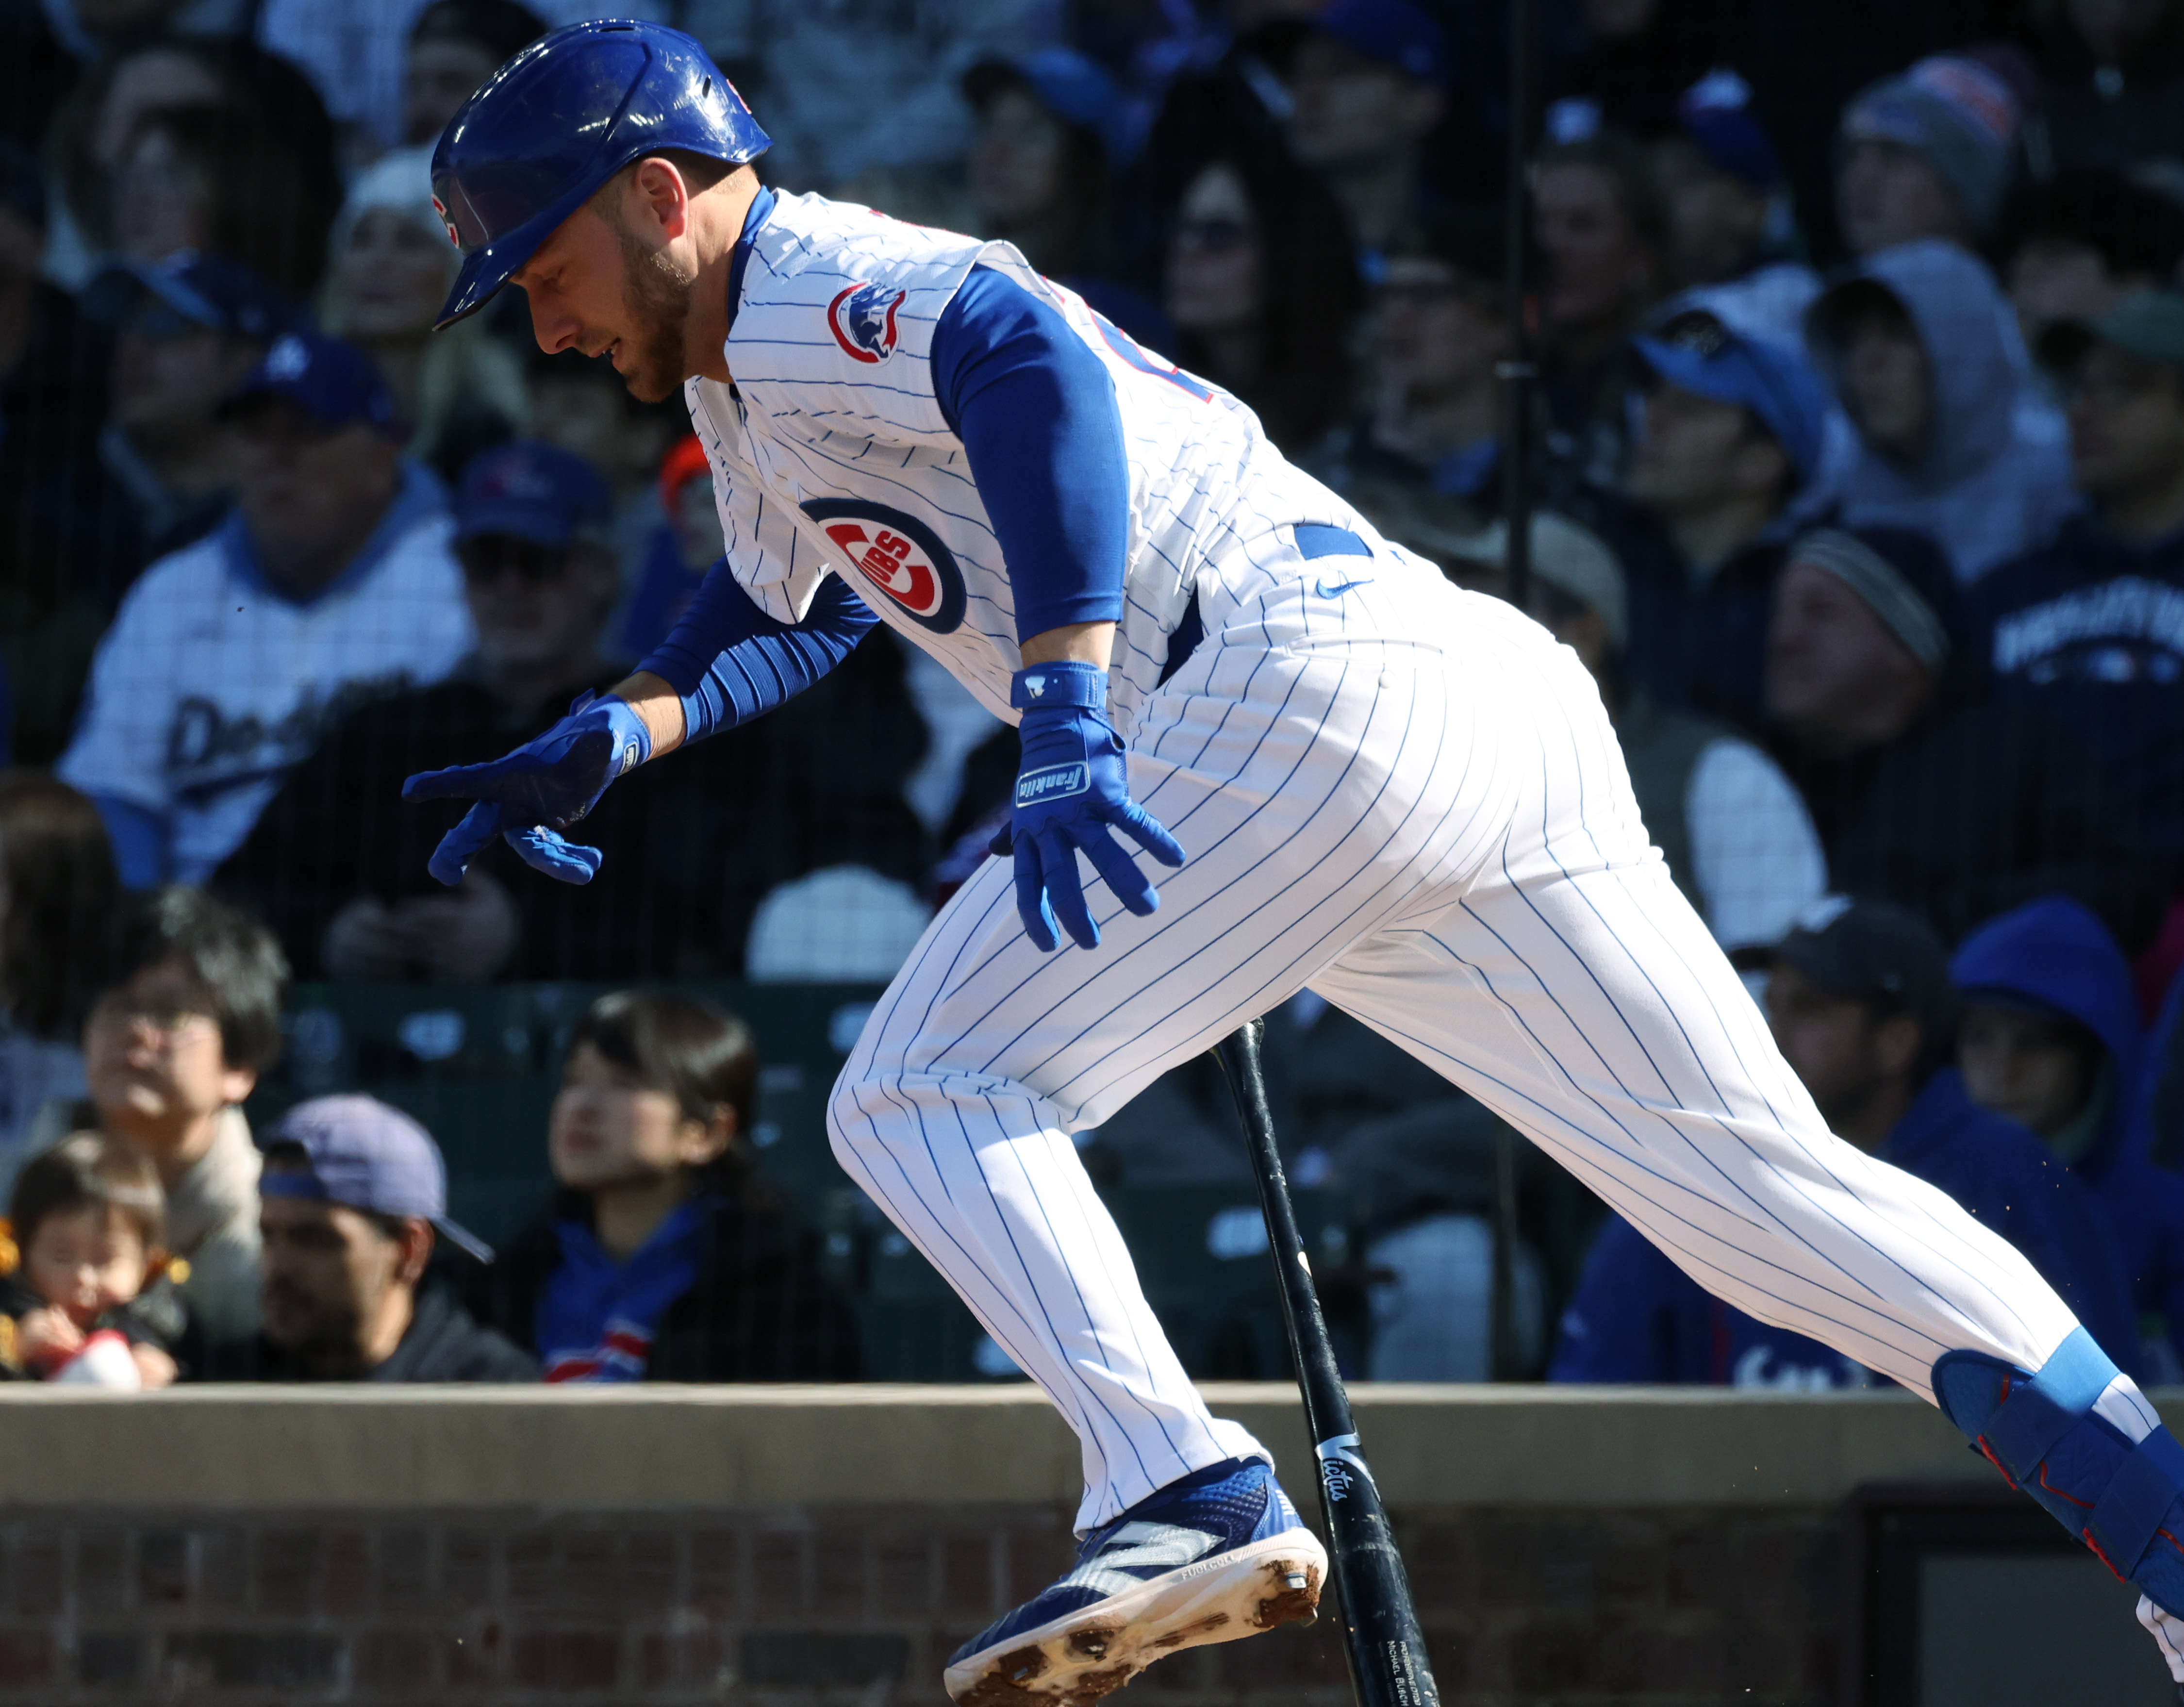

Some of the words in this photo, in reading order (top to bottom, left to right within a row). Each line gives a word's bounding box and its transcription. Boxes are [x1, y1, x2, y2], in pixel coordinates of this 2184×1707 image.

[825, 524, 935, 611] CUBS
[1314, 1432, 1381, 1502] Victus
[1387, 1640, 1400, 1675] MICHAEL
[1395, 1677, 1409, 1707] BUSCH
